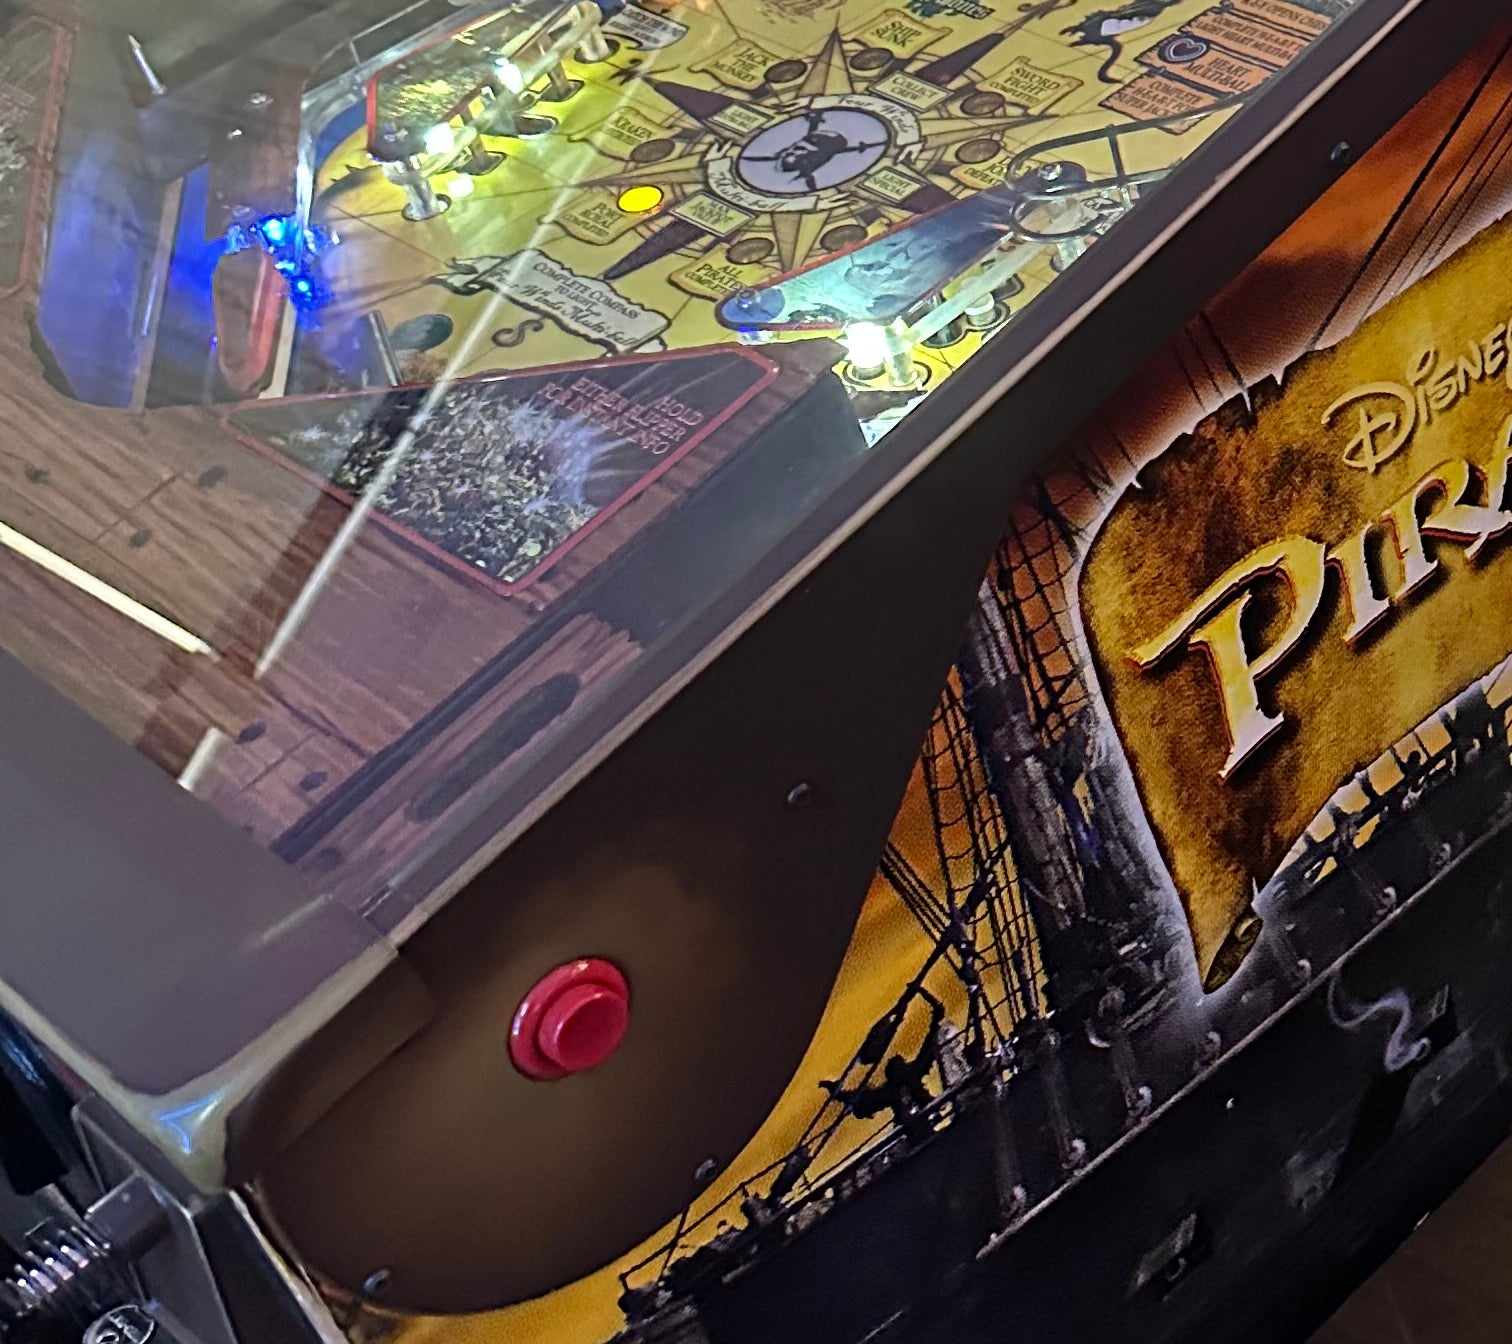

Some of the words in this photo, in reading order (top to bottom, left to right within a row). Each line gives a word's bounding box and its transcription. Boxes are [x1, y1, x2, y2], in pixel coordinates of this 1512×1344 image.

[871, 27, 913, 49] SUNK
[888, 20, 923, 41] SHIP
[1010, 66, 1061, 90] SWORD
[1207, 56, 1253, 78] HEART
[891, 76, 941, 100] COLLECT
[1003, 75, 1049, 97] FIGHT
[1149, 79, 1204, 104] COMPLETE
[532, 261, 589, 294] COMPLETE
[587, 289, 642, 319] COMPASS
[571, 376, 632, 413] EITHER
[624, 403, 687, 443] FLIPPER
[653, 395, 705, 427] HOLD
